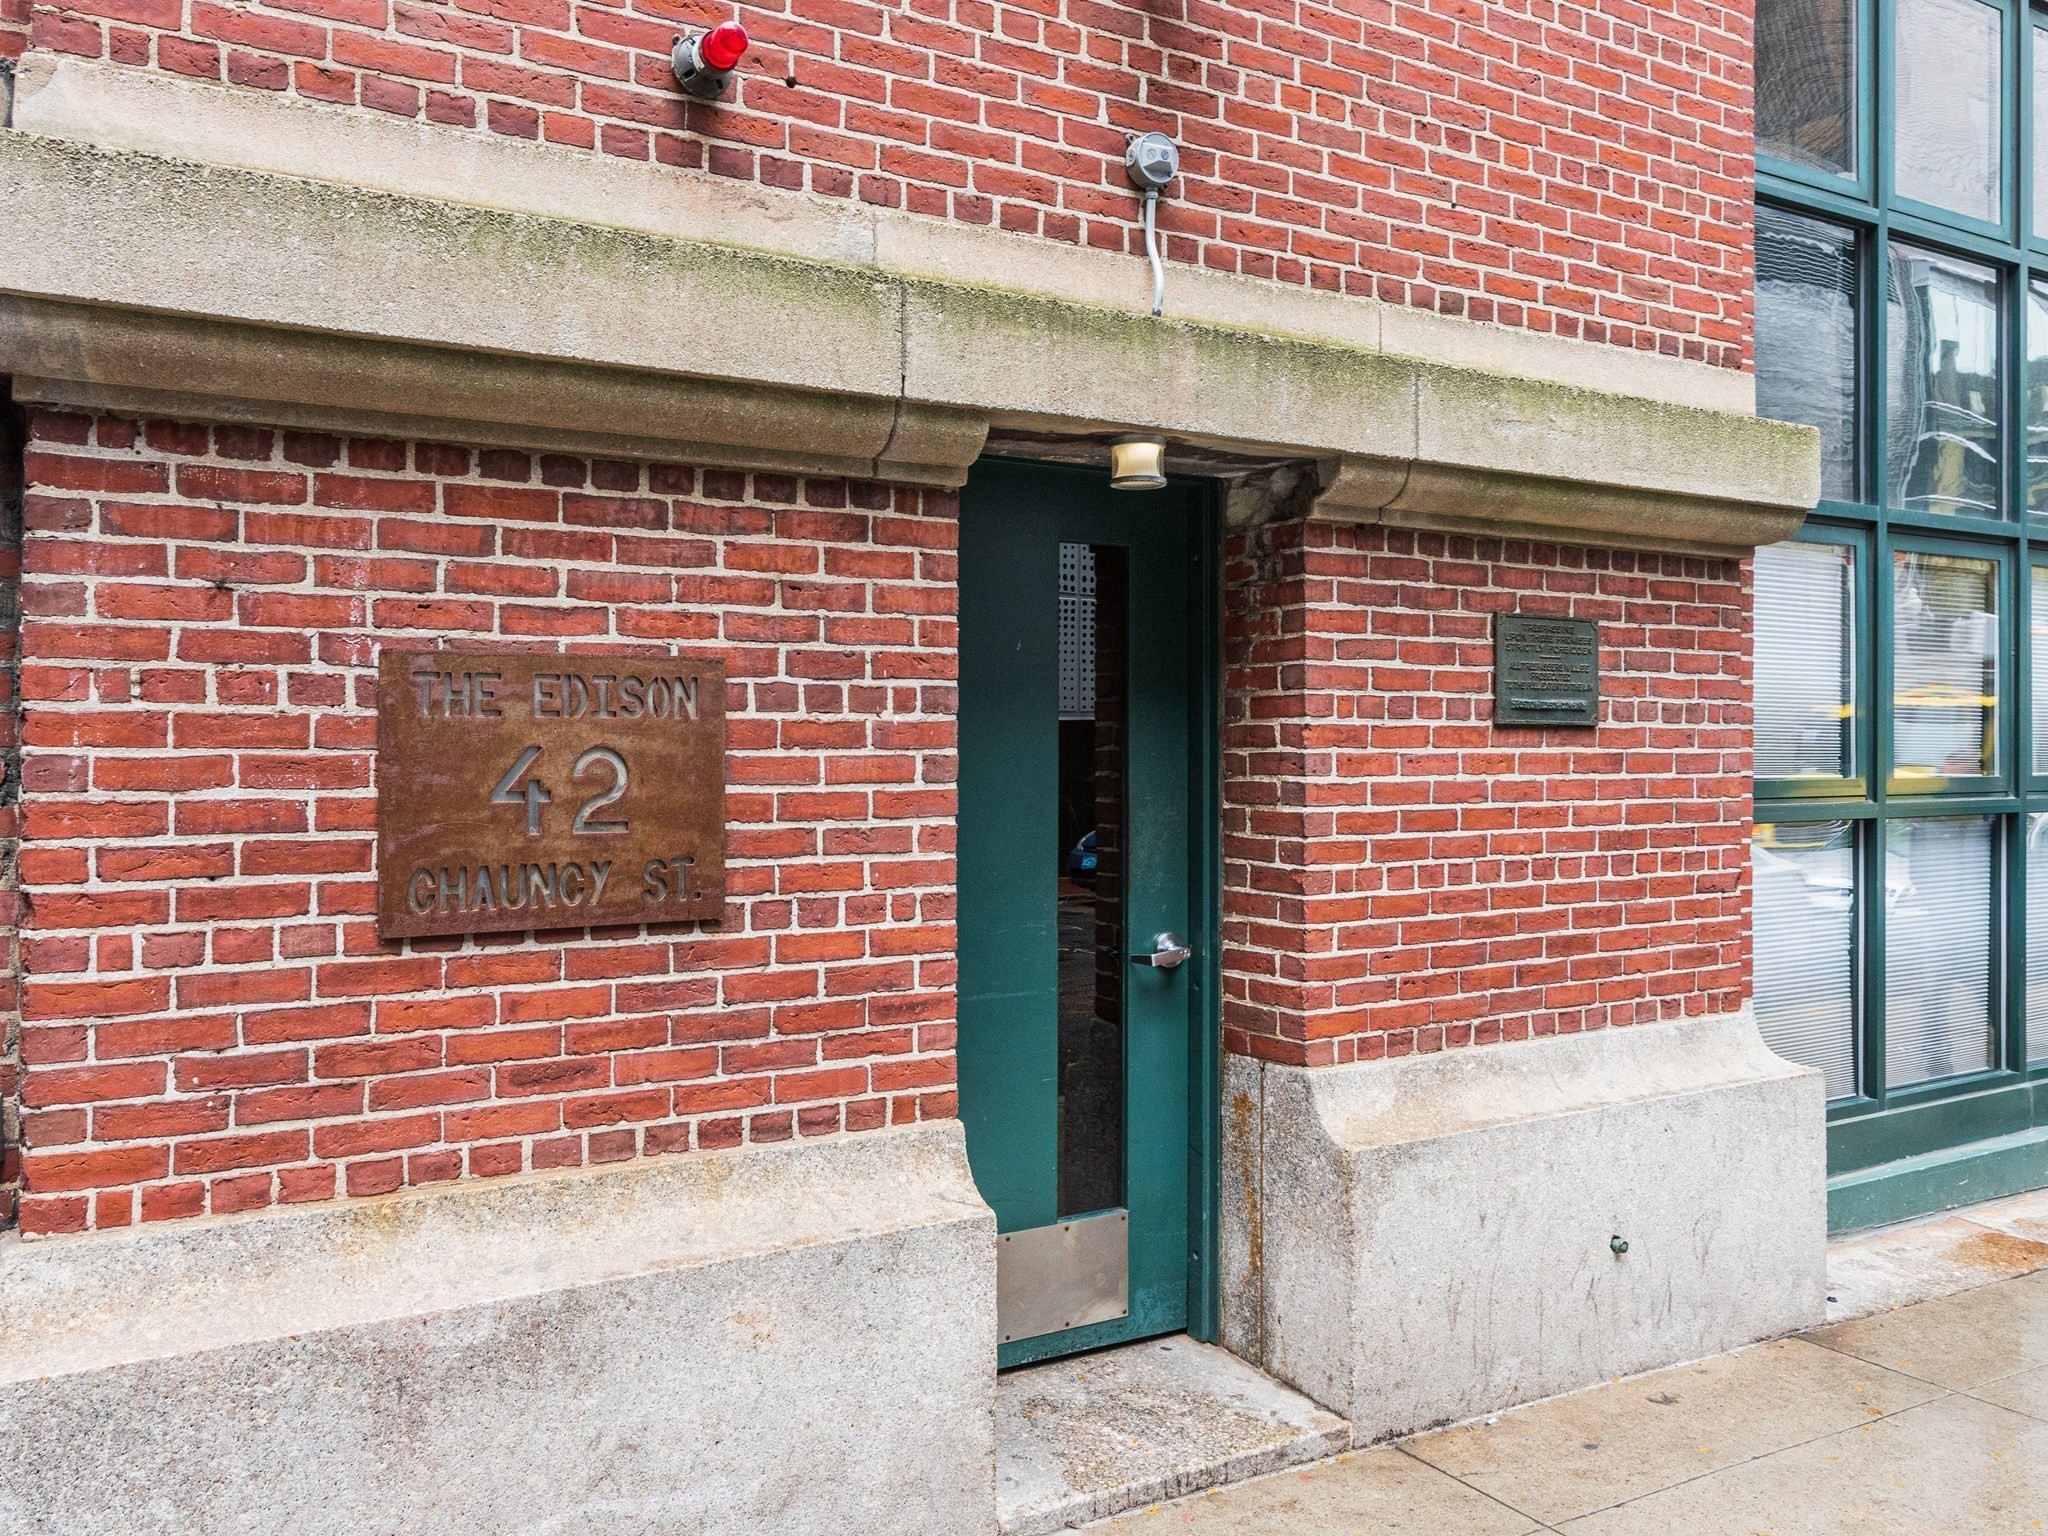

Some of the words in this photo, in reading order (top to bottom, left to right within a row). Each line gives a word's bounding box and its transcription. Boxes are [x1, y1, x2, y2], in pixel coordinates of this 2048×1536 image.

[1505, 632, 1526, 642] UPON
[1529, 633, 1553, 643] THESE
[1556, 634, 1592, 645] PREMISES
[1522, 623, 1574, 634] TRESPASSING
[1505, 642, 1544, 653] STRICTLY
[1548, 644, 1592, 655] FORBIDDEN
[411, 670, 502, 718] THE
[534, 673, 699, 720] EDISON
[490, 745, 629, 836] 42
[408, 860, 613, 915] CHAUNCY
[641, 856, 702, 903] ST.
